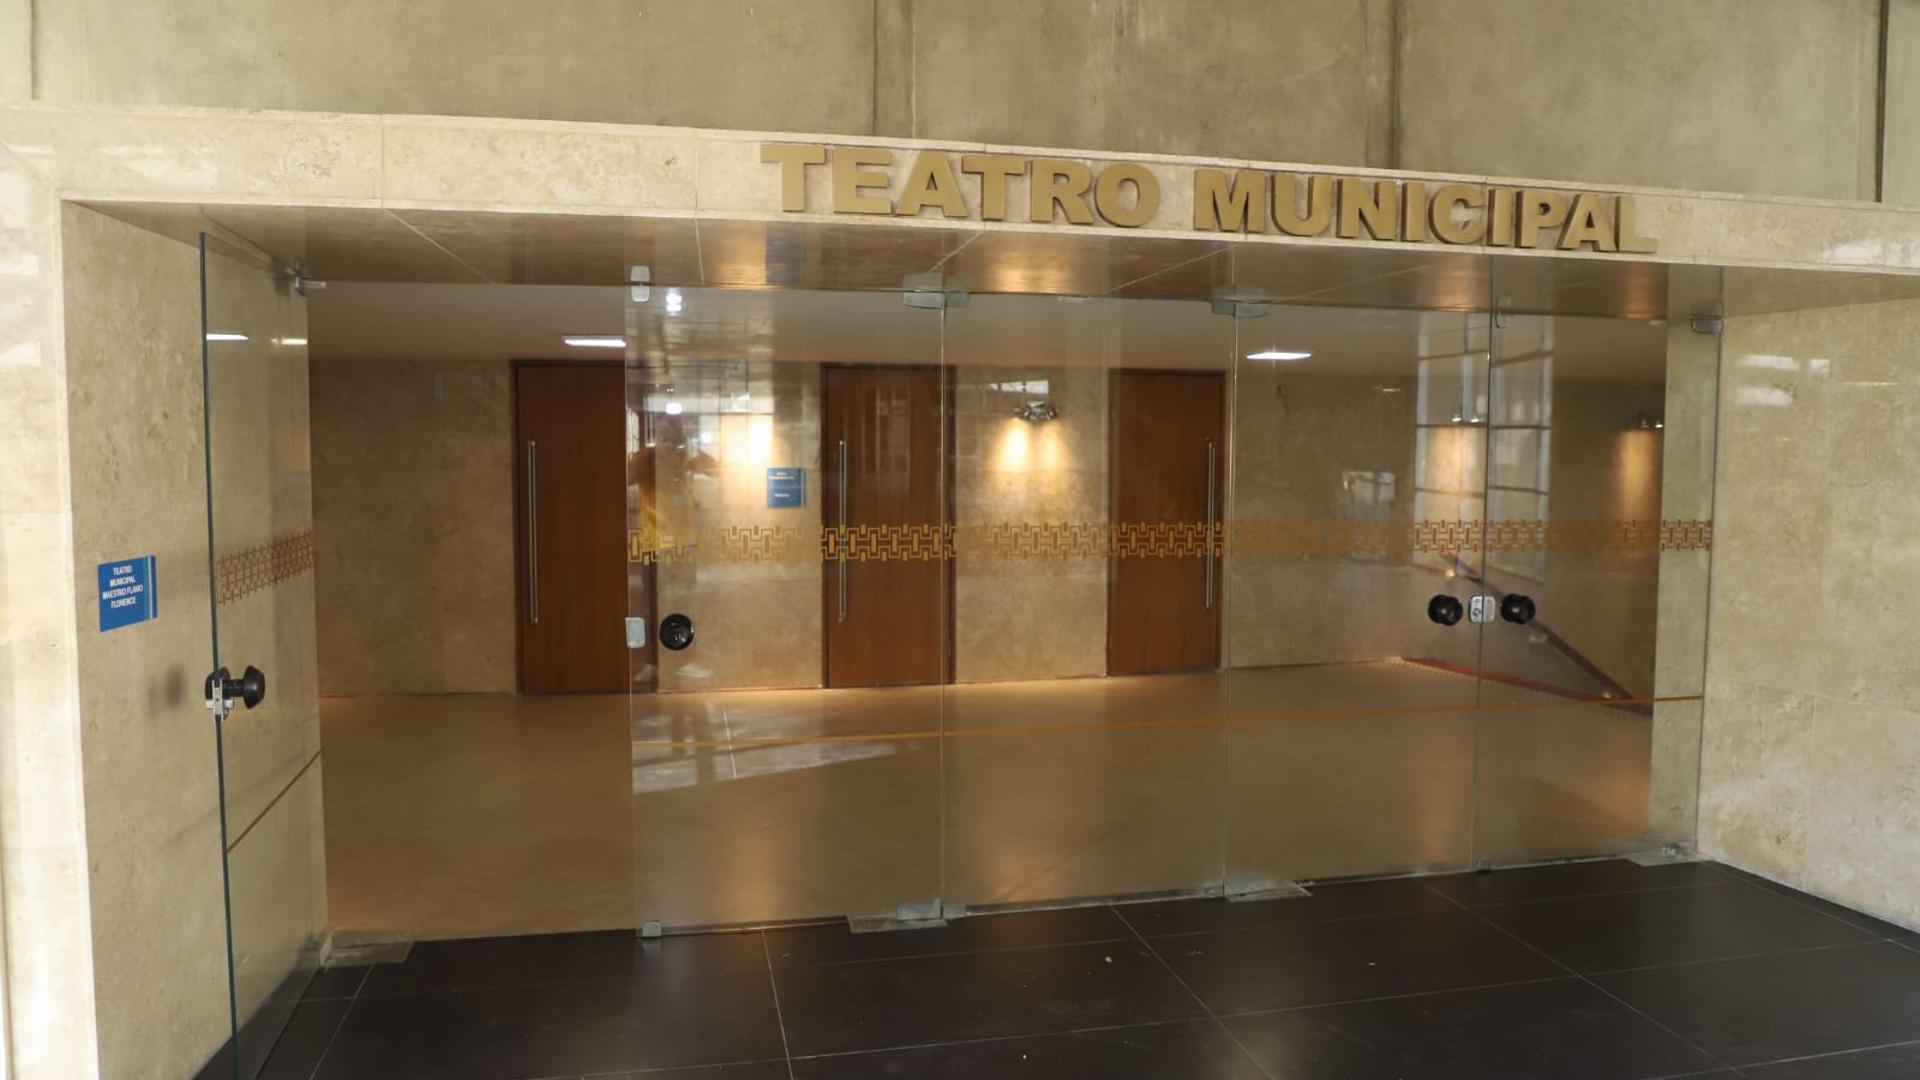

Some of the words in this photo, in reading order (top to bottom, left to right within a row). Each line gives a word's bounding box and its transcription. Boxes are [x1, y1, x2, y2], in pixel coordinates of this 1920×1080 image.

[760, 144, 1161, 228] TEATRO
[1193, 168, 1658, 254] MUNICIPAL
[113, 565, 132, 575] TEATRO
[110, 576, 135, 587] MUNICIPAL
[102, 588, 126, 600] MAESTRO
